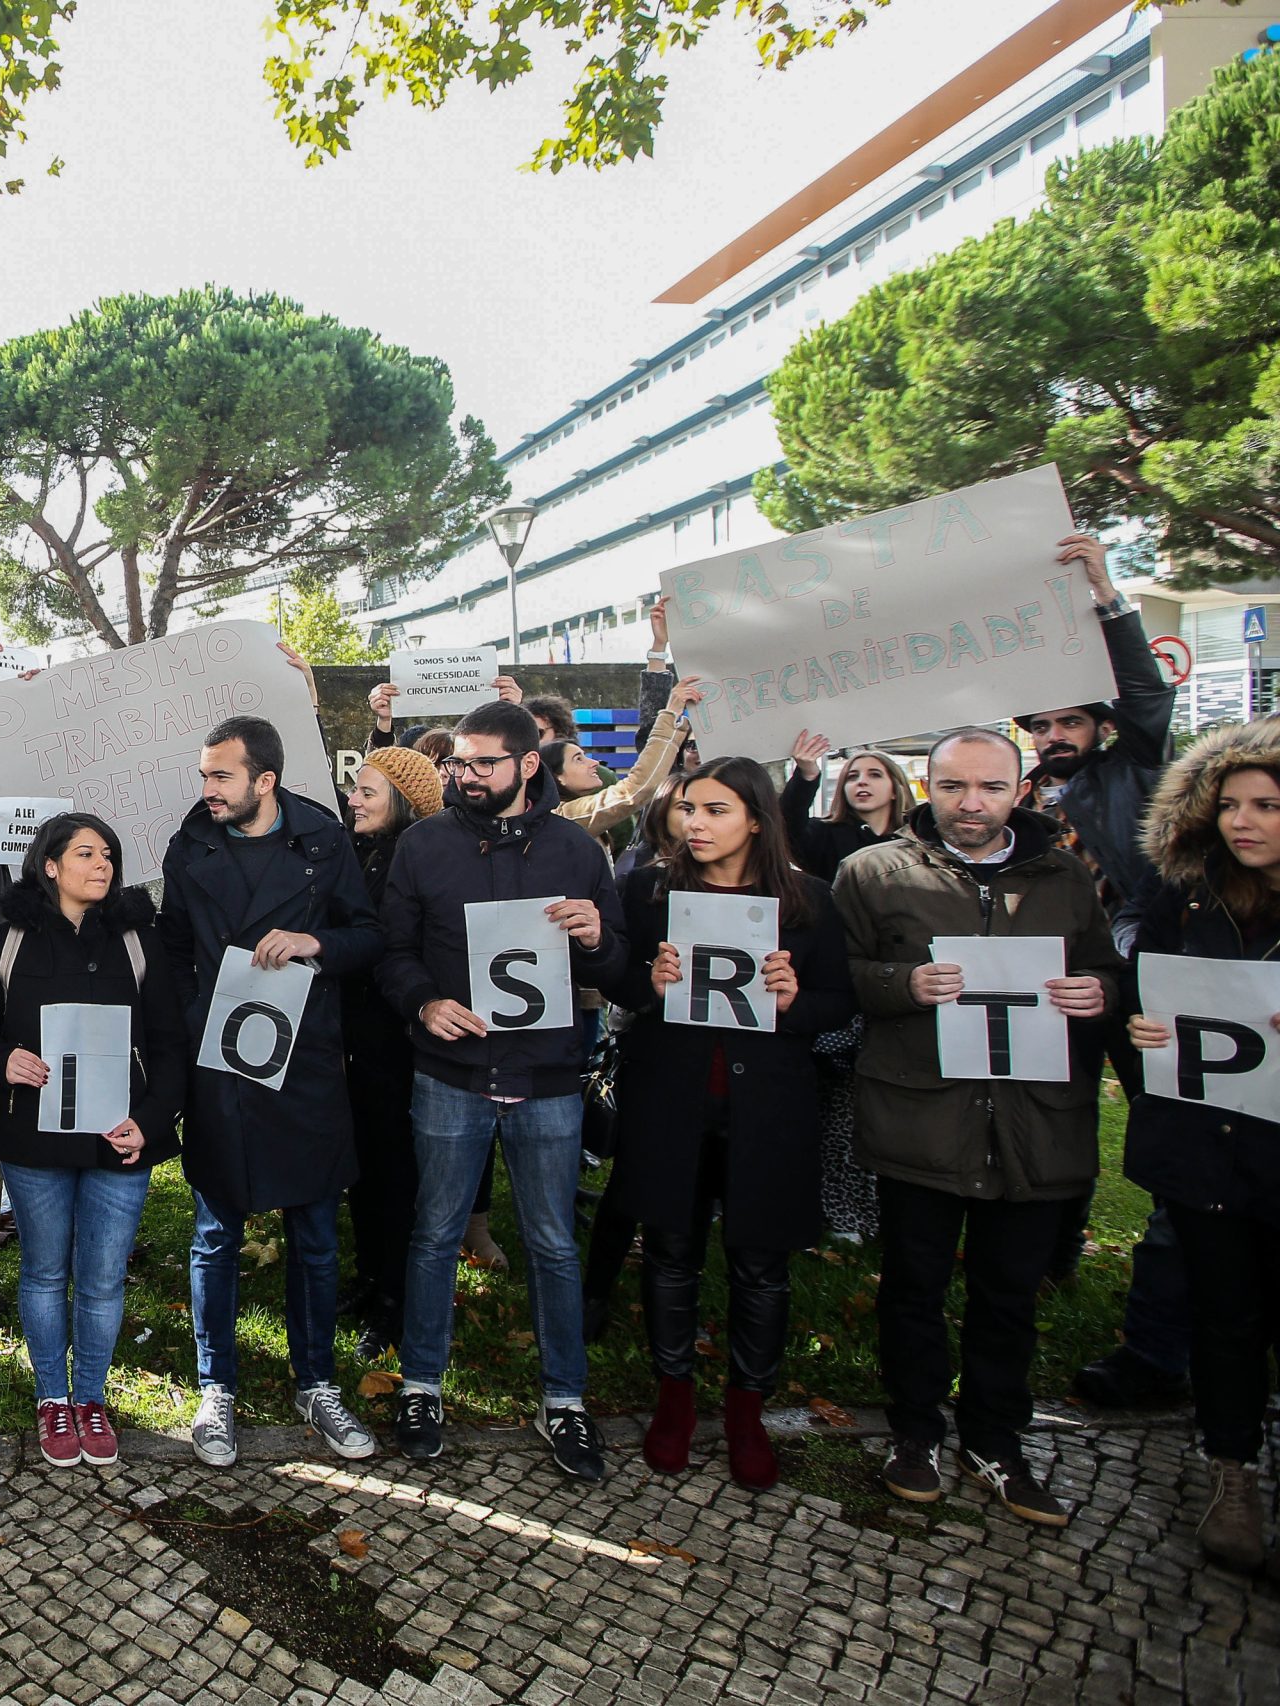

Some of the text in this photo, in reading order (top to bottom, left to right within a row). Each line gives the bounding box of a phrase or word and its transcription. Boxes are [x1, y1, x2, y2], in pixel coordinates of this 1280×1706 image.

[670, 494, 993, 630] BASTA
[821, 586, 873, 630] DE
[46, 627, 243, 720] MESMO
[413, 655, 483, 666] SOMOS SÓ UMA
[24, 680, 264, 782] TRABALHO
[0, 841, 32, 853] CUMP
[8, 822, 39, 836] É PARA
[14, 807, 36, 820] A LEI
[486, 947, 547, 1028] S
[688, 942, 761, 1029] R
[219, 1000, 295, 1081] O
[955, 990, 1040, 1077] T
[1174, 1014, 1268, 1101] P
[59, 1052, 77, 1131] I
